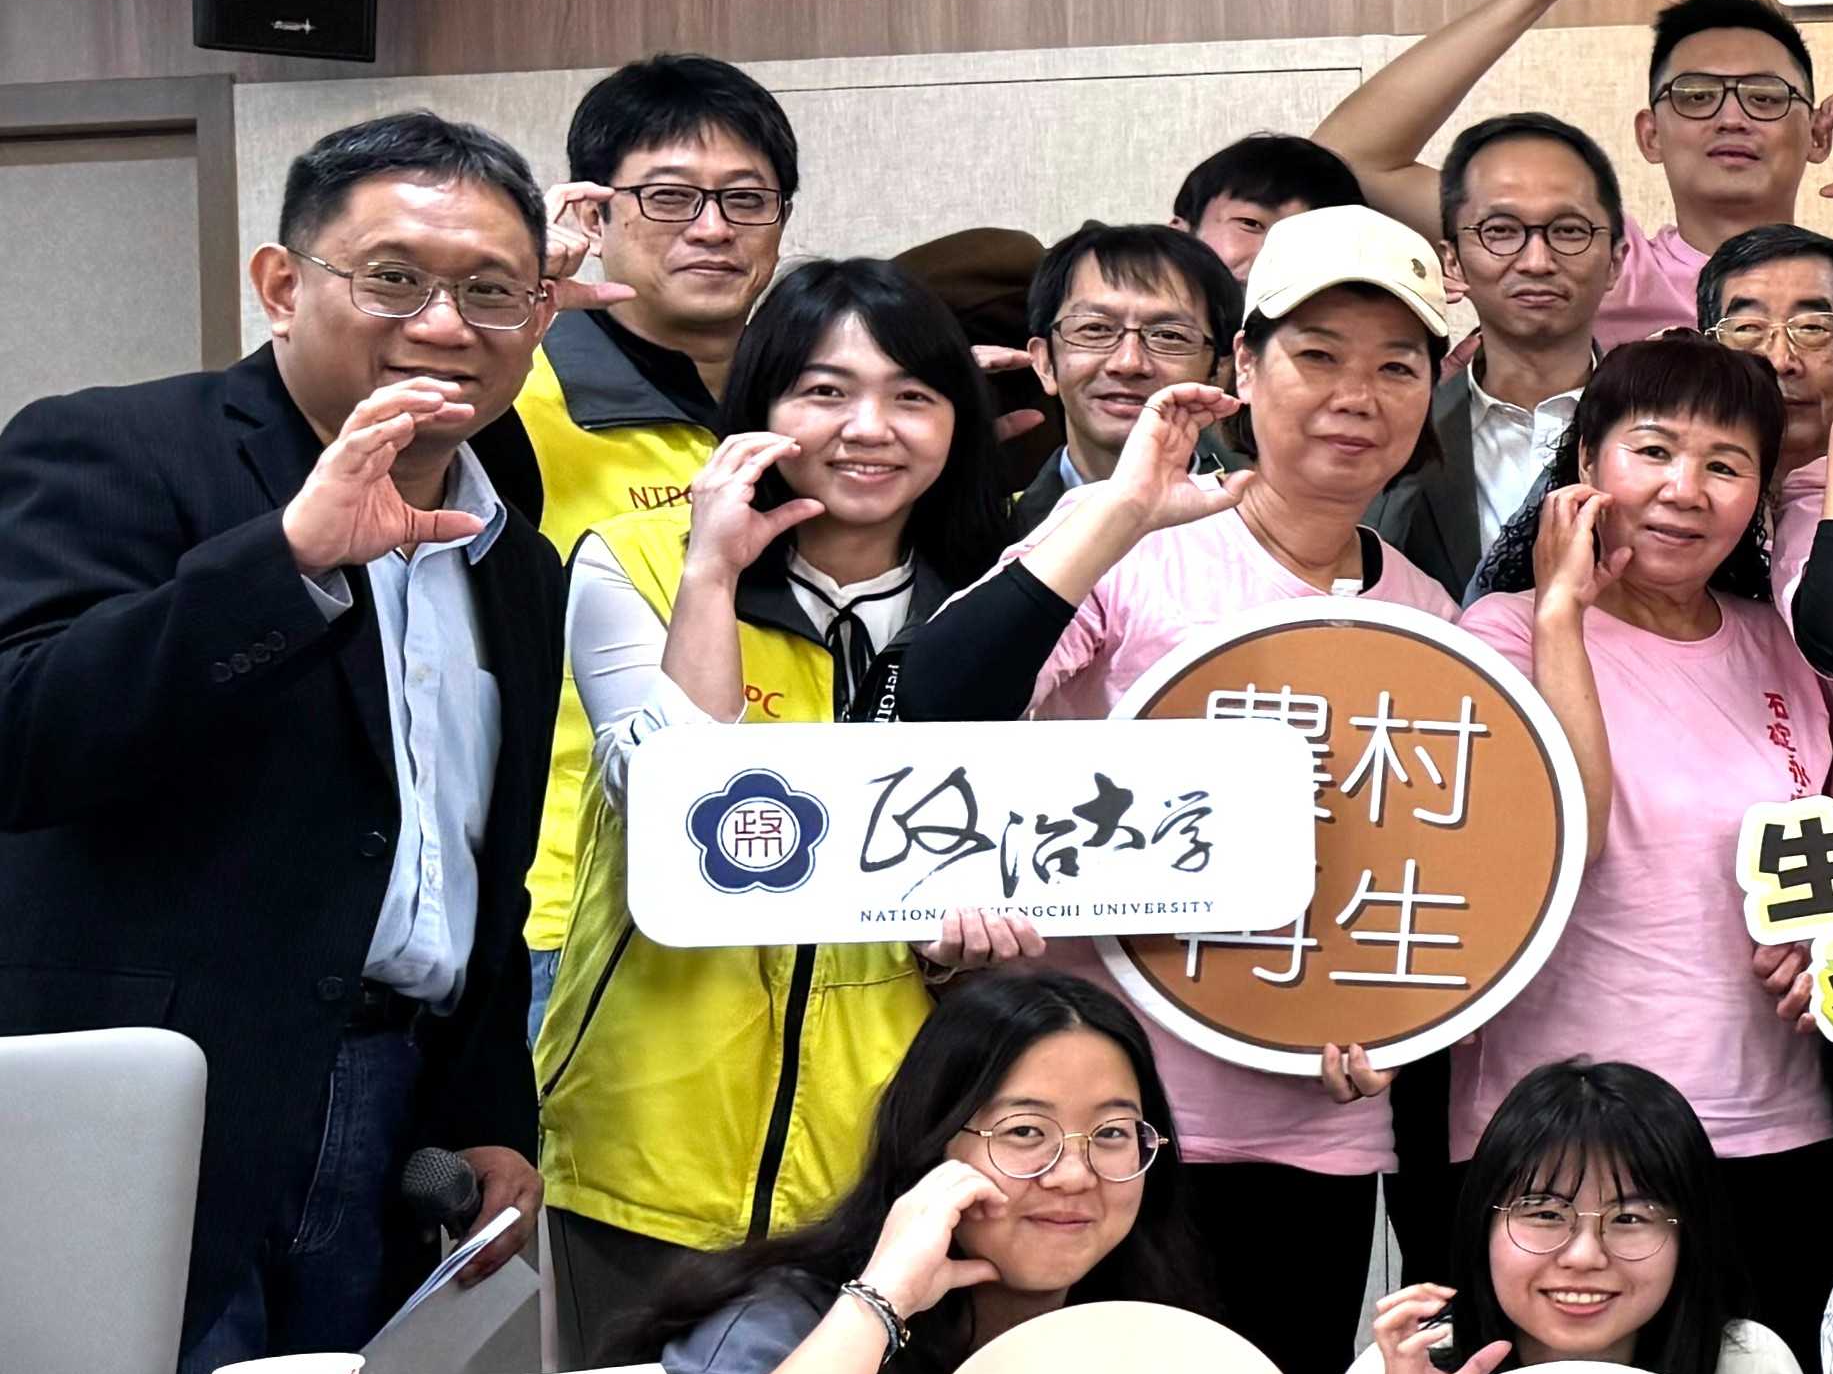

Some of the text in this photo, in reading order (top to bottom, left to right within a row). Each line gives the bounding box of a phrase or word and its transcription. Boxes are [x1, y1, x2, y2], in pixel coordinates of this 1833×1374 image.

[1763, 691, 1813, 801] 石碇永
[860, 907, 946, 923] NATION
[1092, 900, 1214, 917] UNIVERSITY
